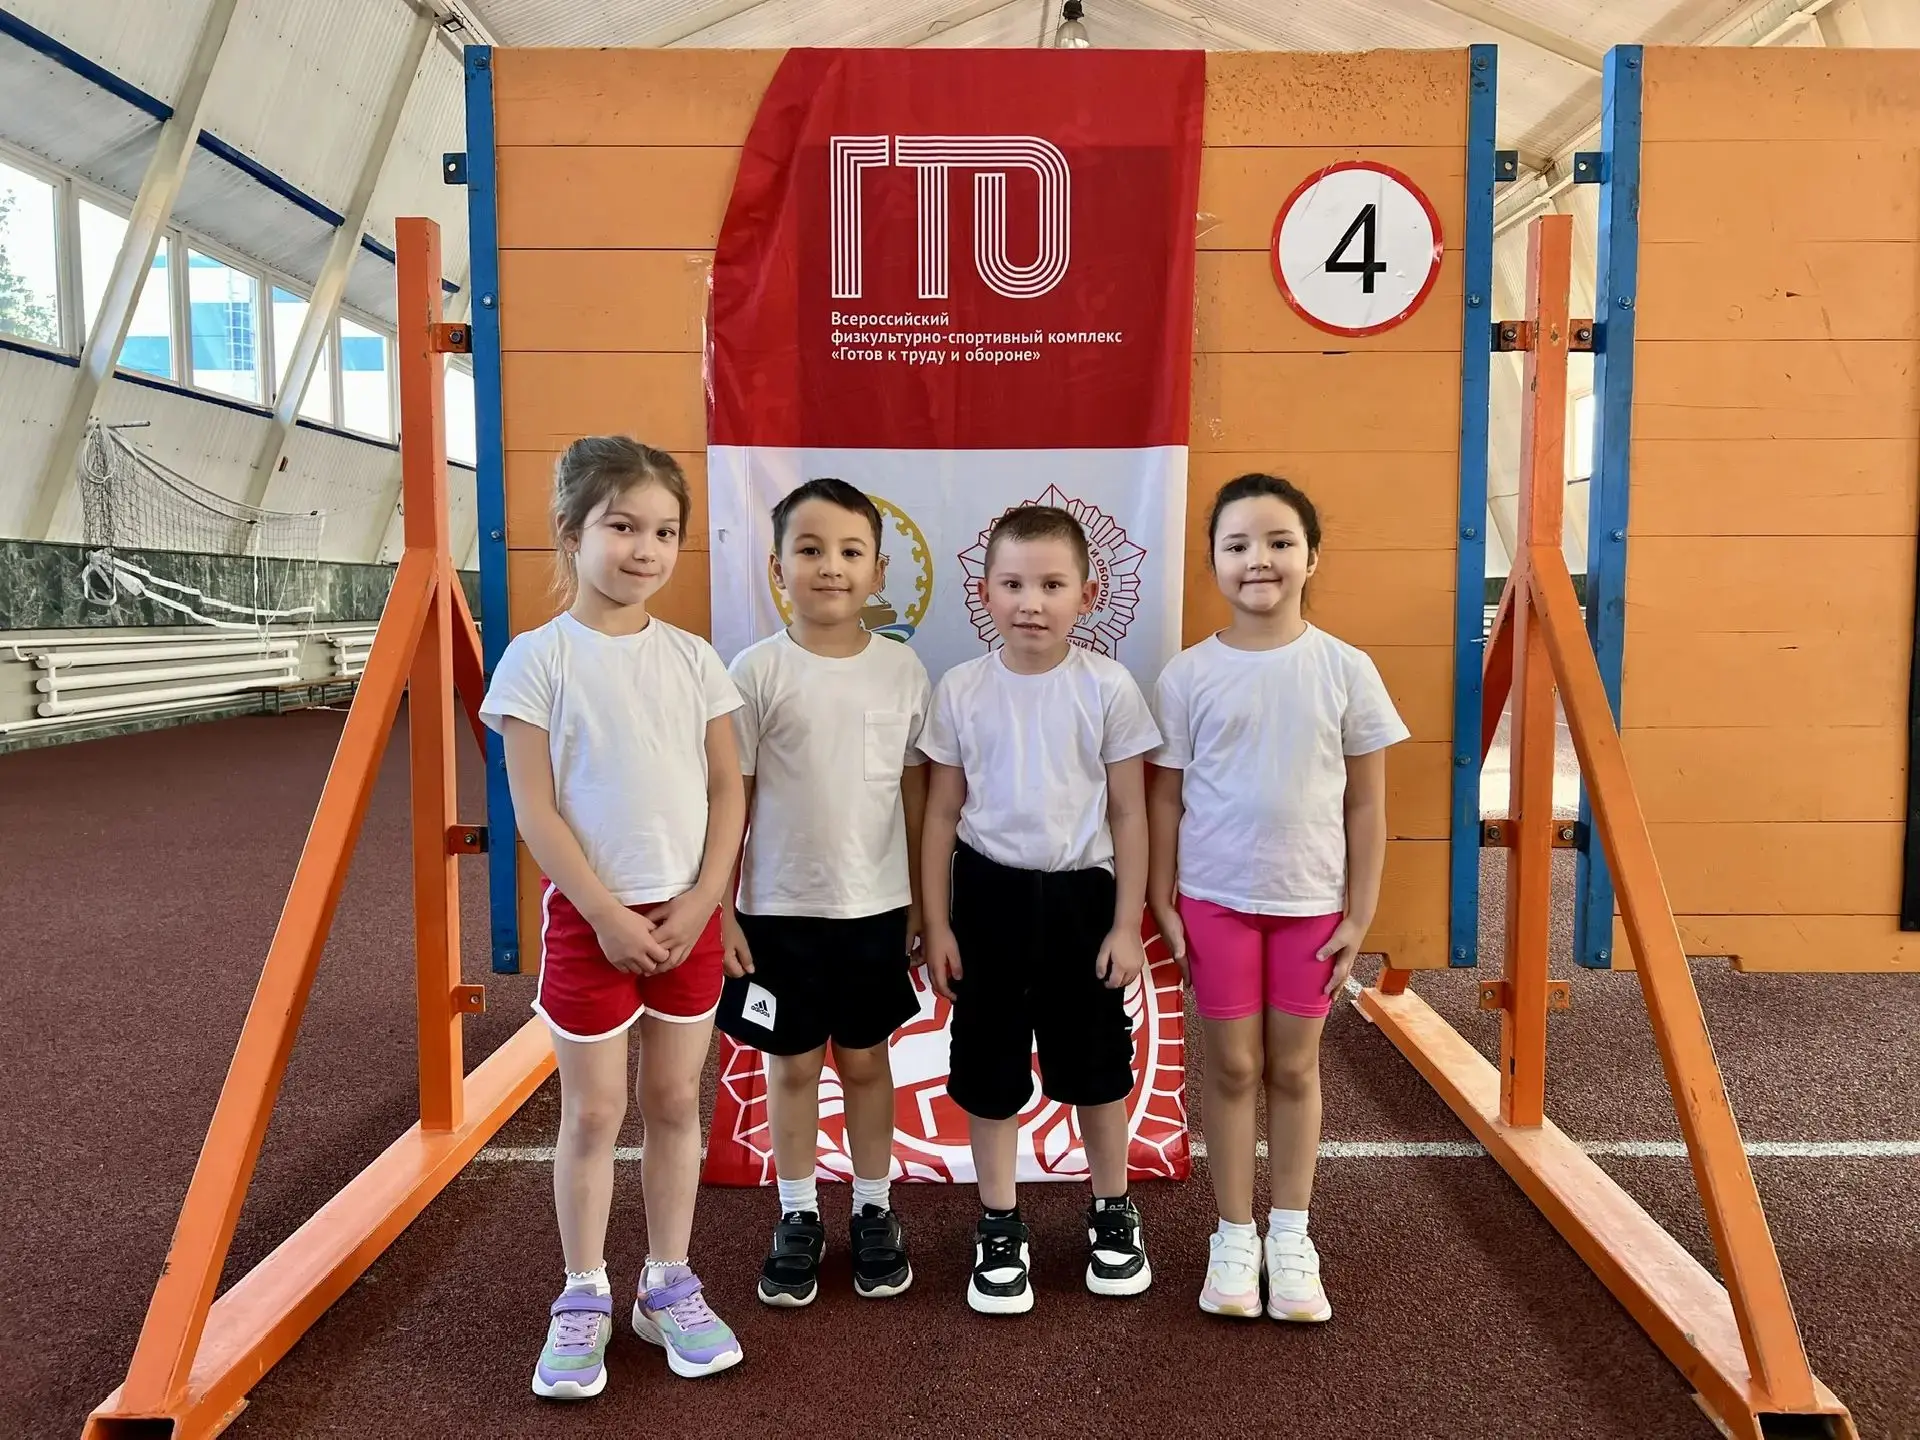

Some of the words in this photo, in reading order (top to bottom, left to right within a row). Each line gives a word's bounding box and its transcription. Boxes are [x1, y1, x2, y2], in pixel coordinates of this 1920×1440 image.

[830, 135, 1071, 299] ГТО
[1325, 203, 1387, 293] 4
[831, 311, 949, 326] Всероссийский
[831, 329, 1043, 345] физкультурно-спортивный
[1048, 331, 1122, 344] комплекс
[831, 346, 882, 361] «Готов
[887, 349, 896, 361] к
[901, 350, 946, 365] труду
[951, 351, 959, 361] и
[965, 347, 1041, 365] обороне»
[1095, 558, 1109, 613] ОБОРОНЕ
